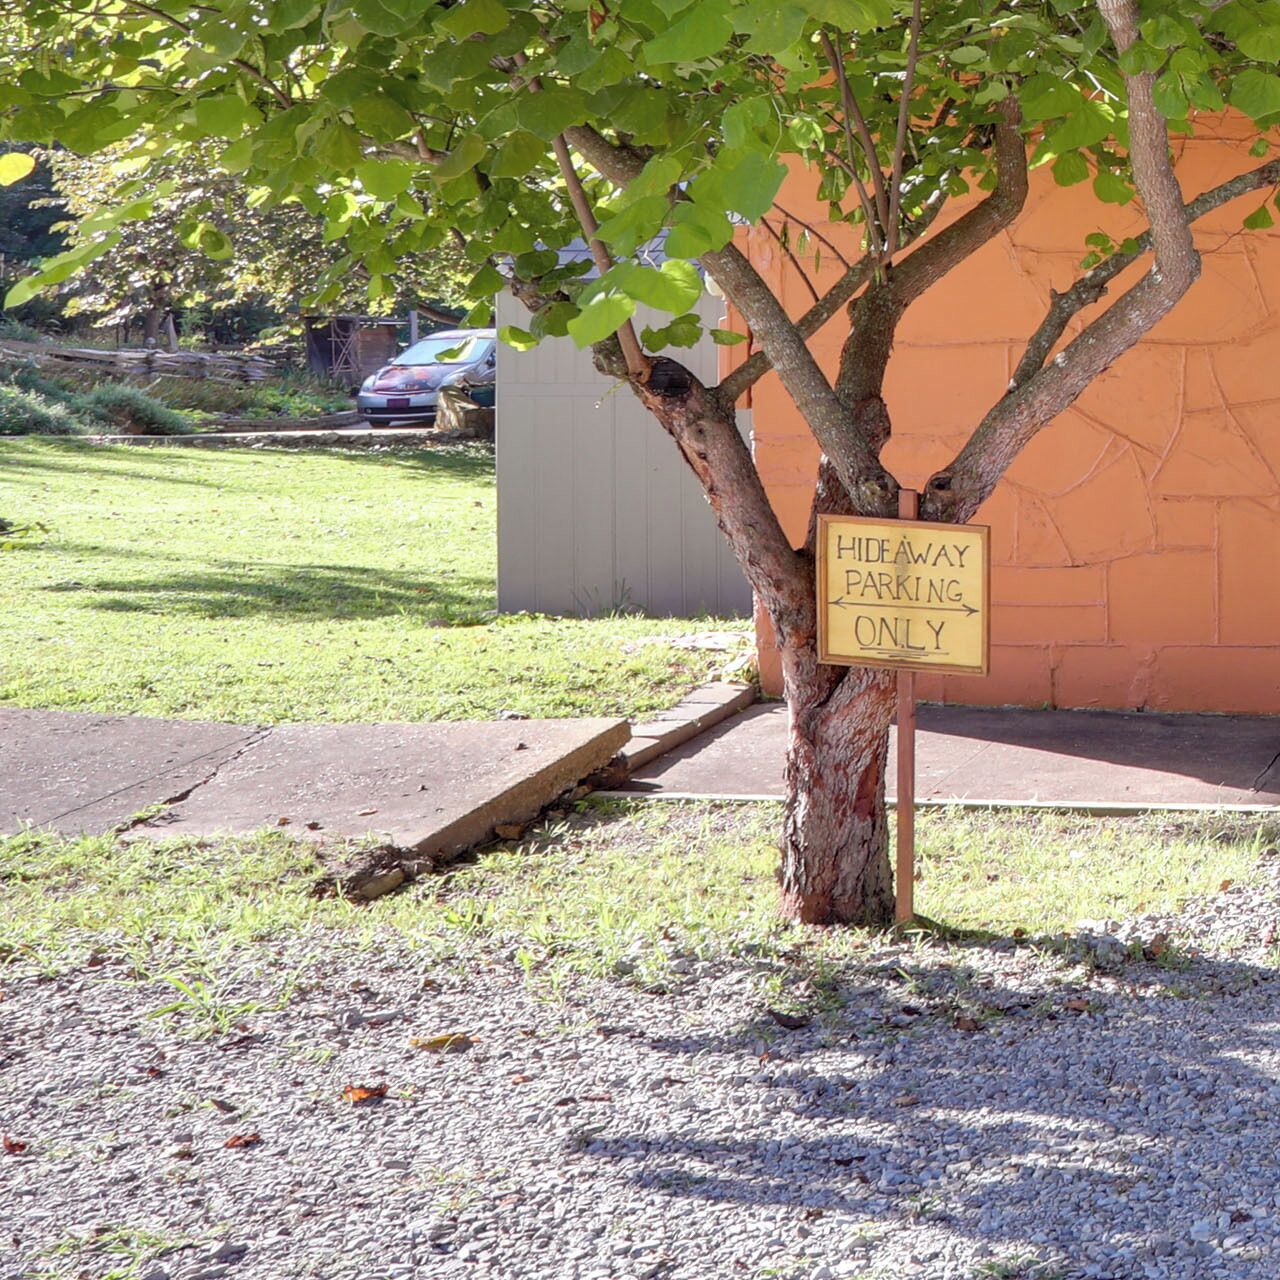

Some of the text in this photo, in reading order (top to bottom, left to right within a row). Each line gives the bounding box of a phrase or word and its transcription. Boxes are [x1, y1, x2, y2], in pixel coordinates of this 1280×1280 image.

[837, 535, 970, 568] HIDEAWAY
[845, 570, 963, 603] PARKING
[855, 615, 945, 650] ONLY
